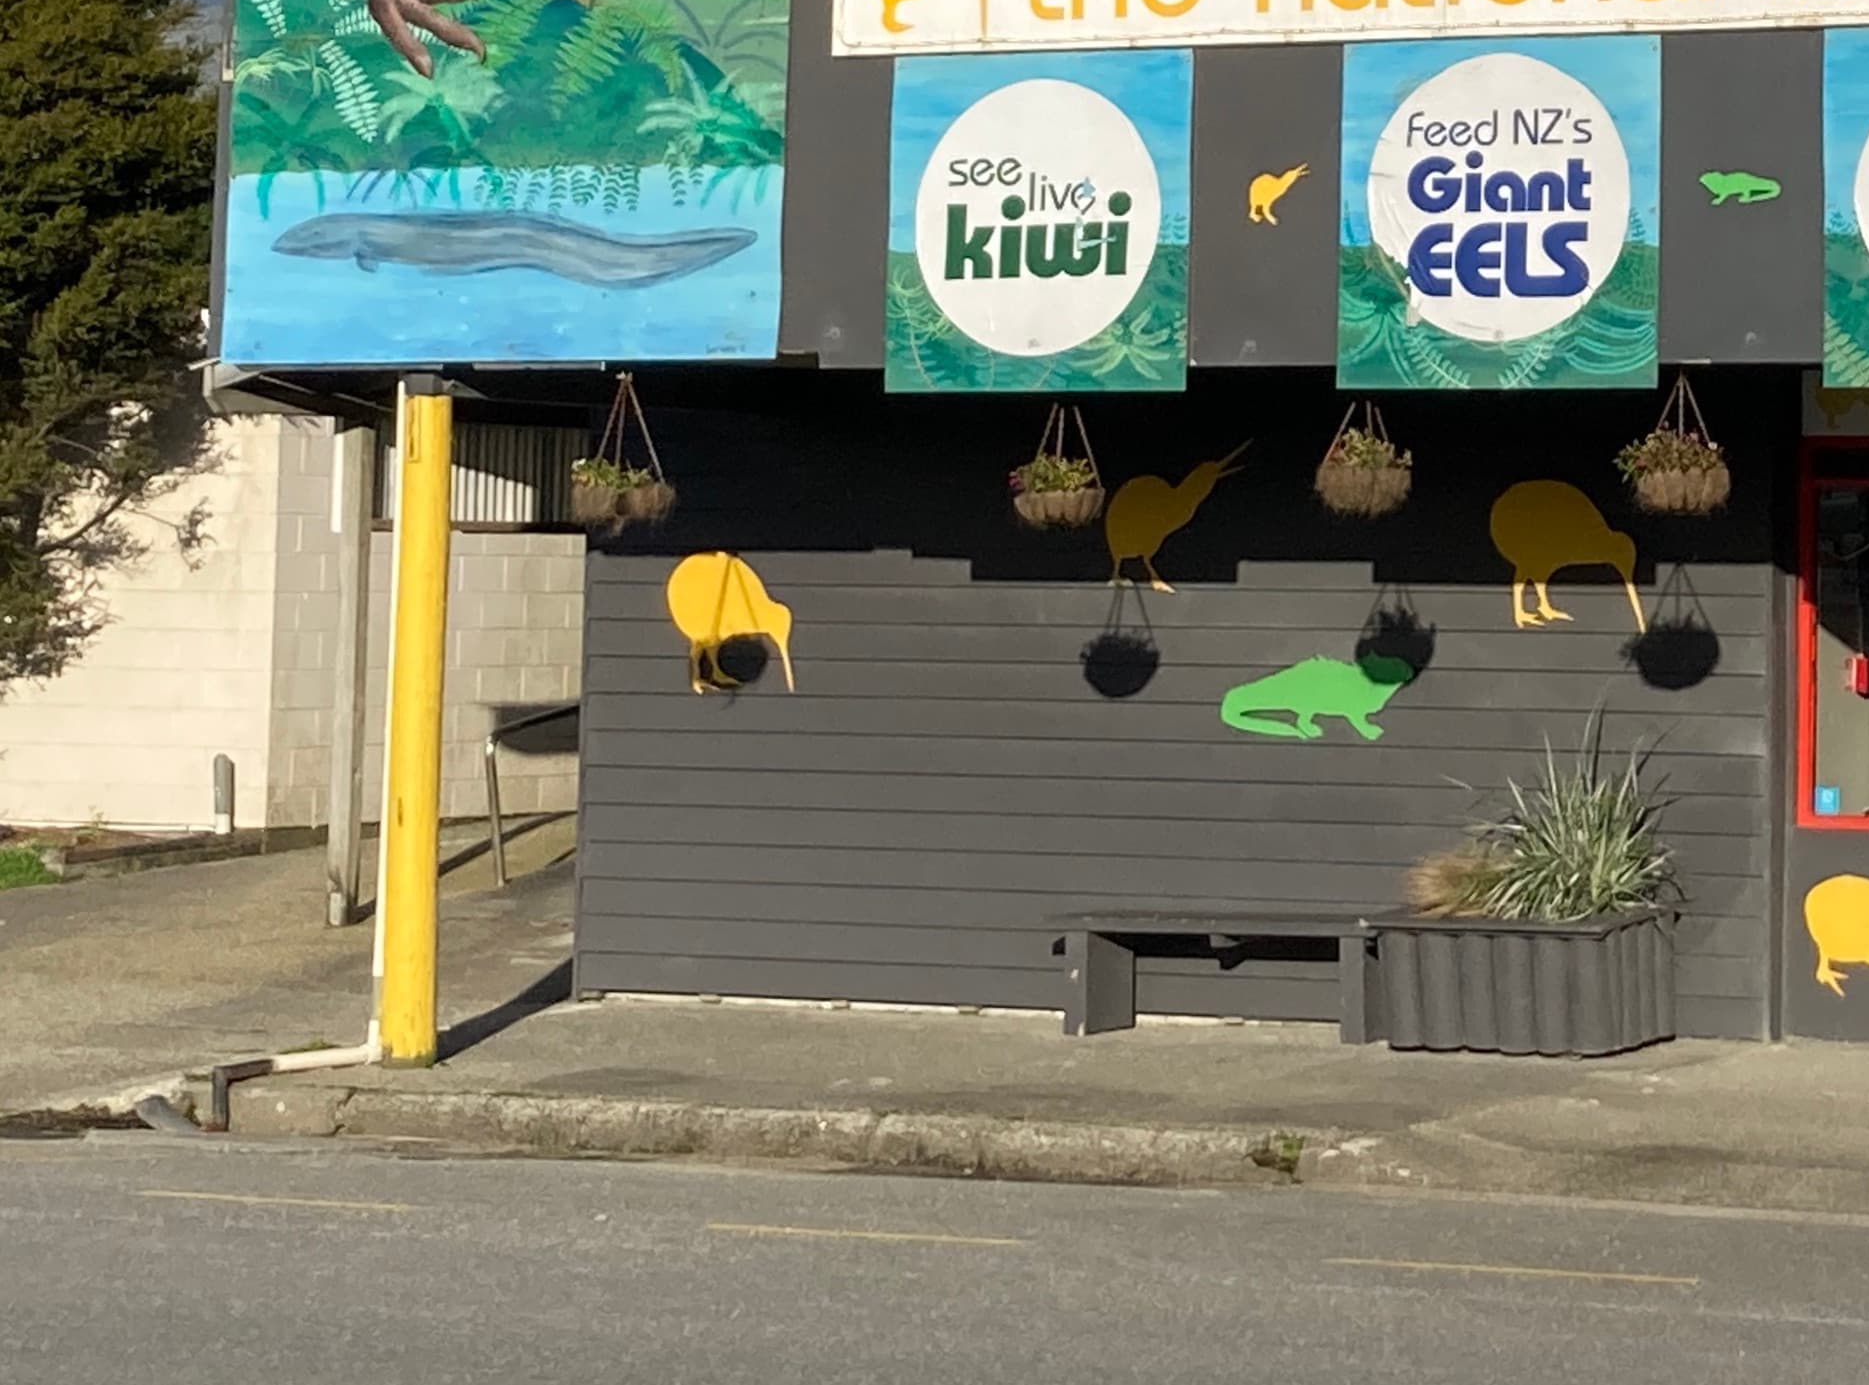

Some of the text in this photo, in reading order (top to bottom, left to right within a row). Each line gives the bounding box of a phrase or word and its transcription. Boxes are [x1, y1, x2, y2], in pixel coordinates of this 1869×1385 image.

[1406, 108, 1592, 147] Feed NZ's
[948, 157, 1096, 215] see live
[1407, 150, 1592, 213] Giant
[945, 191, 1132, 280] kiwi
[1407, 221, 1590, 298] EELS
